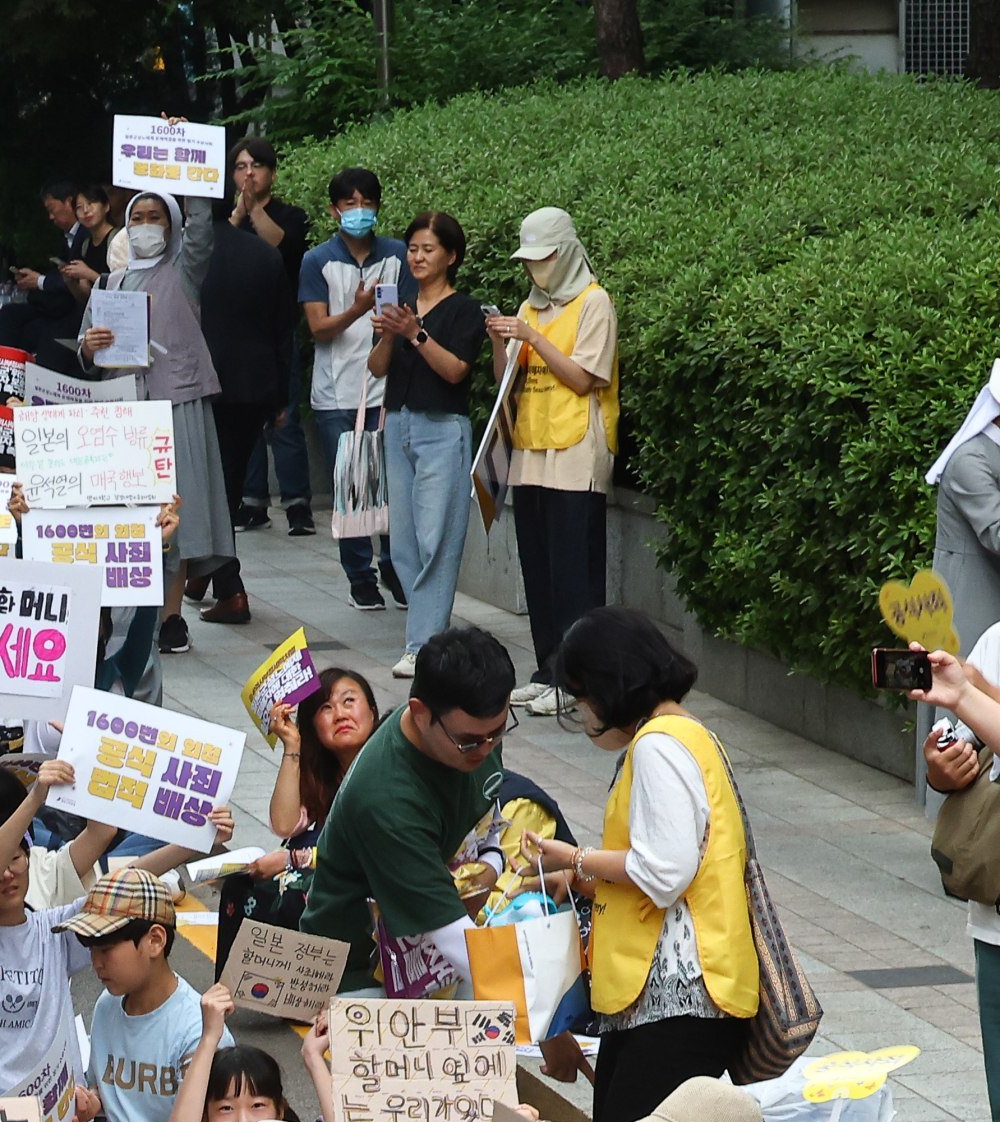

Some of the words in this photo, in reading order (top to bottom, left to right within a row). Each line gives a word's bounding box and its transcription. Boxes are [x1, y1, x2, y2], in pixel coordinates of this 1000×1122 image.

[150, 125, 186, 138] 1600차
[120, 144, 169, 161] 우리는
[174, 147, 207, 164] 함께
[133, 161, 181, 180] 평화로
[187, 167, 219, 184] 간다
[56, 382, 92, 399] 1600차
[21, 427, 69, 456] 일본의
[35, 524, 109, 539] 1600번의
[114, 523, 146, 538] 외침
[51, 541, 98, 564] 공식
[105, 541, 152, 563] 사죄
[105, 566, 153, 588] 배상
[86, 709, 179, 753] 1600번의
[181, 737, 222, 766] 외침
[96, 736, 158, 780] 공식
[160, 756, 223, 798] 사죄
[87, 766, 150, 811] 법적
[152, 786, 214, 827] 배상
[250, 926, 284, 955] 일본
[294, 941, 337, 967] 정부는
[241, 947, 293, 971] 할머니께
[344, 1003, 466, 1051] 위안부
[352, 1050, 433, 1093] 할머니
[442, 1049, 509, 1085] 옆에
